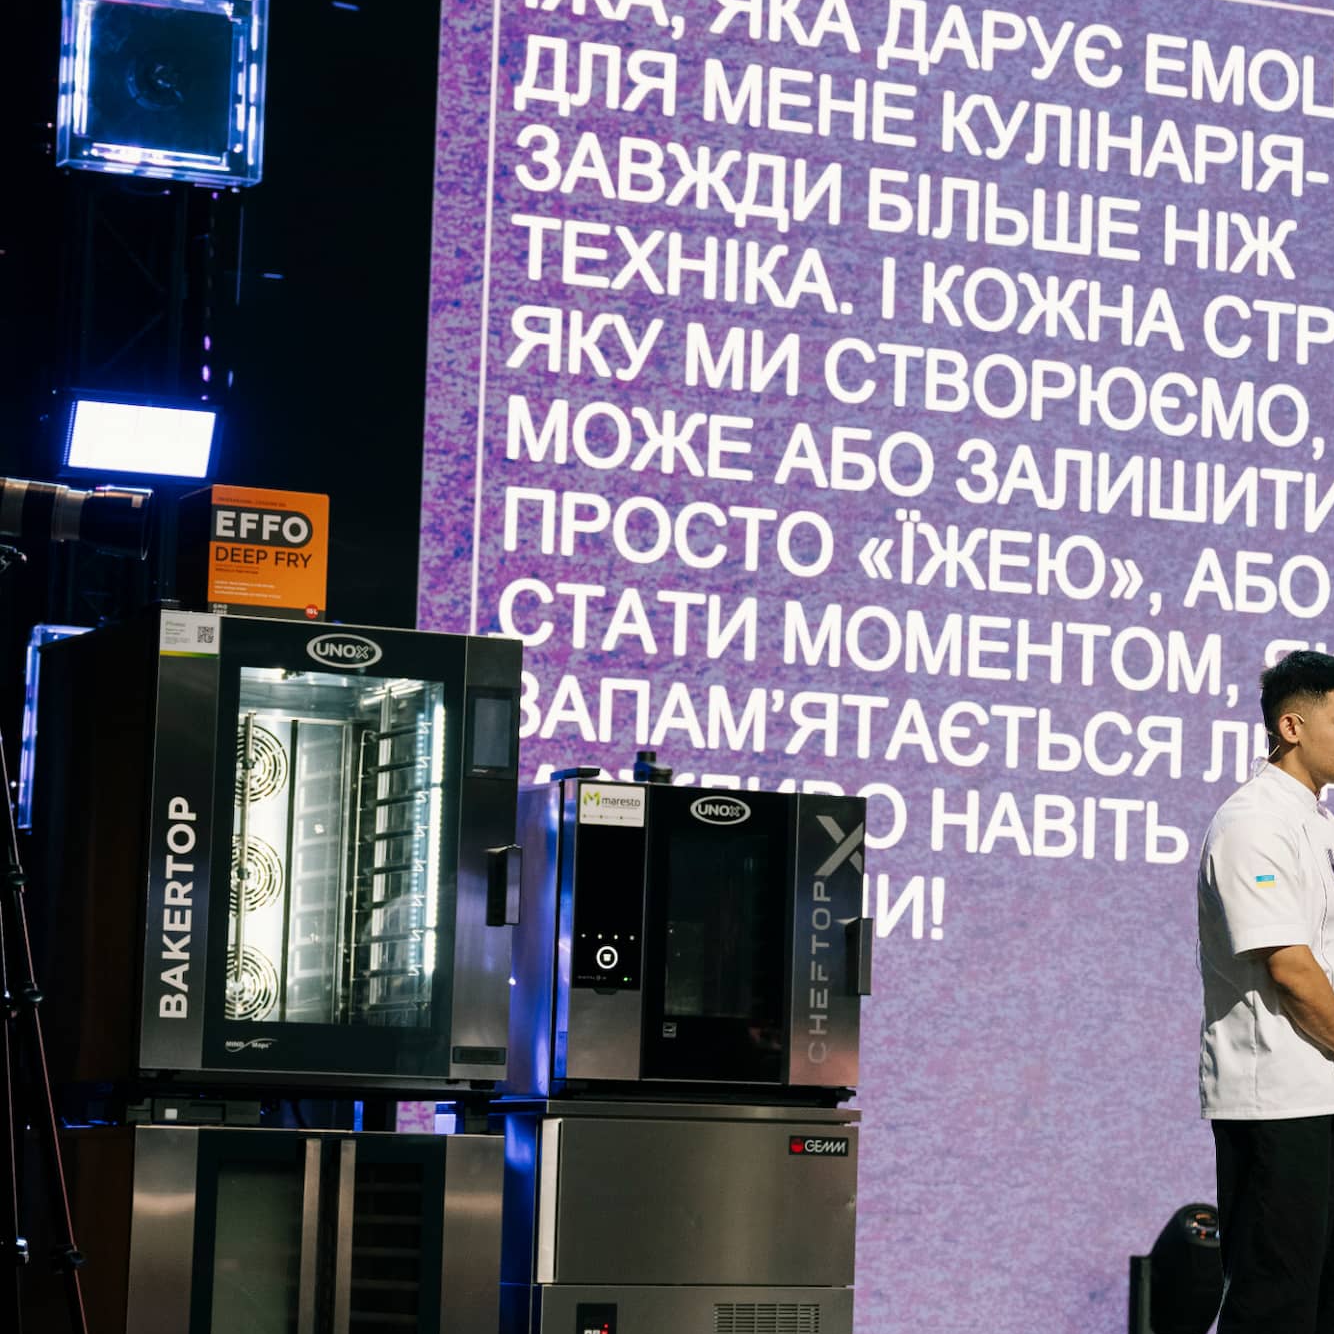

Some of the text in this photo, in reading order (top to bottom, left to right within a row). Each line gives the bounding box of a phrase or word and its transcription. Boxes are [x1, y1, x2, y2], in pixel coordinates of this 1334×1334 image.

[514, 34, 677, 117] ДЛЯ
[703, 58, 917, 148] МЕНЕ
[515, 124, 1298, 280] ЗАВЖДИ БІЛЬШЕ НІЖ
[511, 214, 853, 315] ТЕХНІКА.
[881, 256, 896, 319] І
[922, 261, 1185, 352] КОЖНА
[506, 305, 1325, 461] ЯКУ МИ СТВОРЮЄМО,
[507, 394, 754, 481] МОЖЕ
[774, 423, 935, 497] АБО
[215, 546, 313, 569] DEEP FRY
[216, 510, 309, 544] EFFO
[503, 486, 1331, 619] ПРОСТО «ЇЖЕЮ», АБО
[316, 643, 369, 660] UNOX
[497, 578, 758, 661] СТАТИ
[783, 600, 1238, 708] МОМЕНТОМ,
[601, 796, 641, 807] maresto
[931, 787, 1189, 864] НАВІТЬ
[159, 795, 197, 1020] BAKERTOP
[807, 880, 831, 1064] CHEFTOP
[804, 1139, 847, 1154] GEMM
